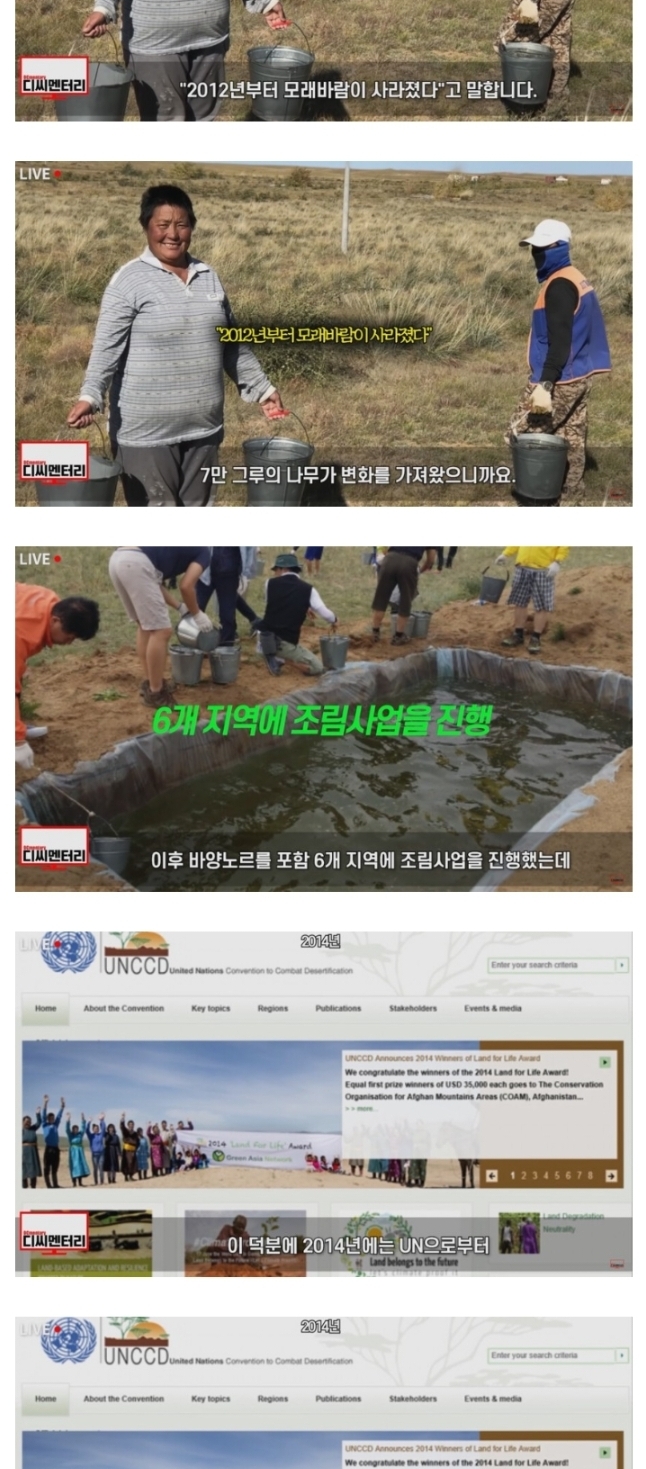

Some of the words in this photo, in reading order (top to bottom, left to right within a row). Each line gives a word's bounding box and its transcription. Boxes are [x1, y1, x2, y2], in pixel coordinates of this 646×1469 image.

[105, 957, 169, 975] UNCCD
[169, 967, 193, 975] United
[194, 967, 224, 975] Nations
[225, 967, 264, 975] Convention
[266, 967, 274, 975] to
[275, 967, 302, 975] Combat
[304, 967, 353, 975] Desertification
[35, 1004, 57, 1013] Home
[84, 1004, 106, 1013] About
[108, 1004, 120, 1013] the
[121, 1004, 165, 1013] Convention
[191, 1004, 205, 1013] Key
[207, 1004, 231, 1013] topics
[257, 1004, 289, 1013] Regions
[315, 1004, 362, 1013] Publications
[388, 1004, 438, 1013] Stakeholders
[464, 1004, 489, 1013] Events
[491, 1004, 498, 1013] &
[499, 1004, 522, 1013] media
[370, 1257, 386, 1266] Land
[388, 1257, 413, 1268] belongs
[415, 1257, 423, 1266] to
[424, 1257, 436, 1266] the
[437, 1257, 459, 1266] future
[345, 1445, 374, 1453] UNCCD
[375, 1445, 414, 1453] Announces
[415, 1445, 433, 1453] 2014
[435, 1445, 465, 1453] Winners
[466, 1445, 472, 1453] of
[474, 1445, 491, 1453] Land
[492, 1445, 502, 1453] for
[504, 1445, 516, 1453] Life
[518, 1445, 541, 1453] Award
